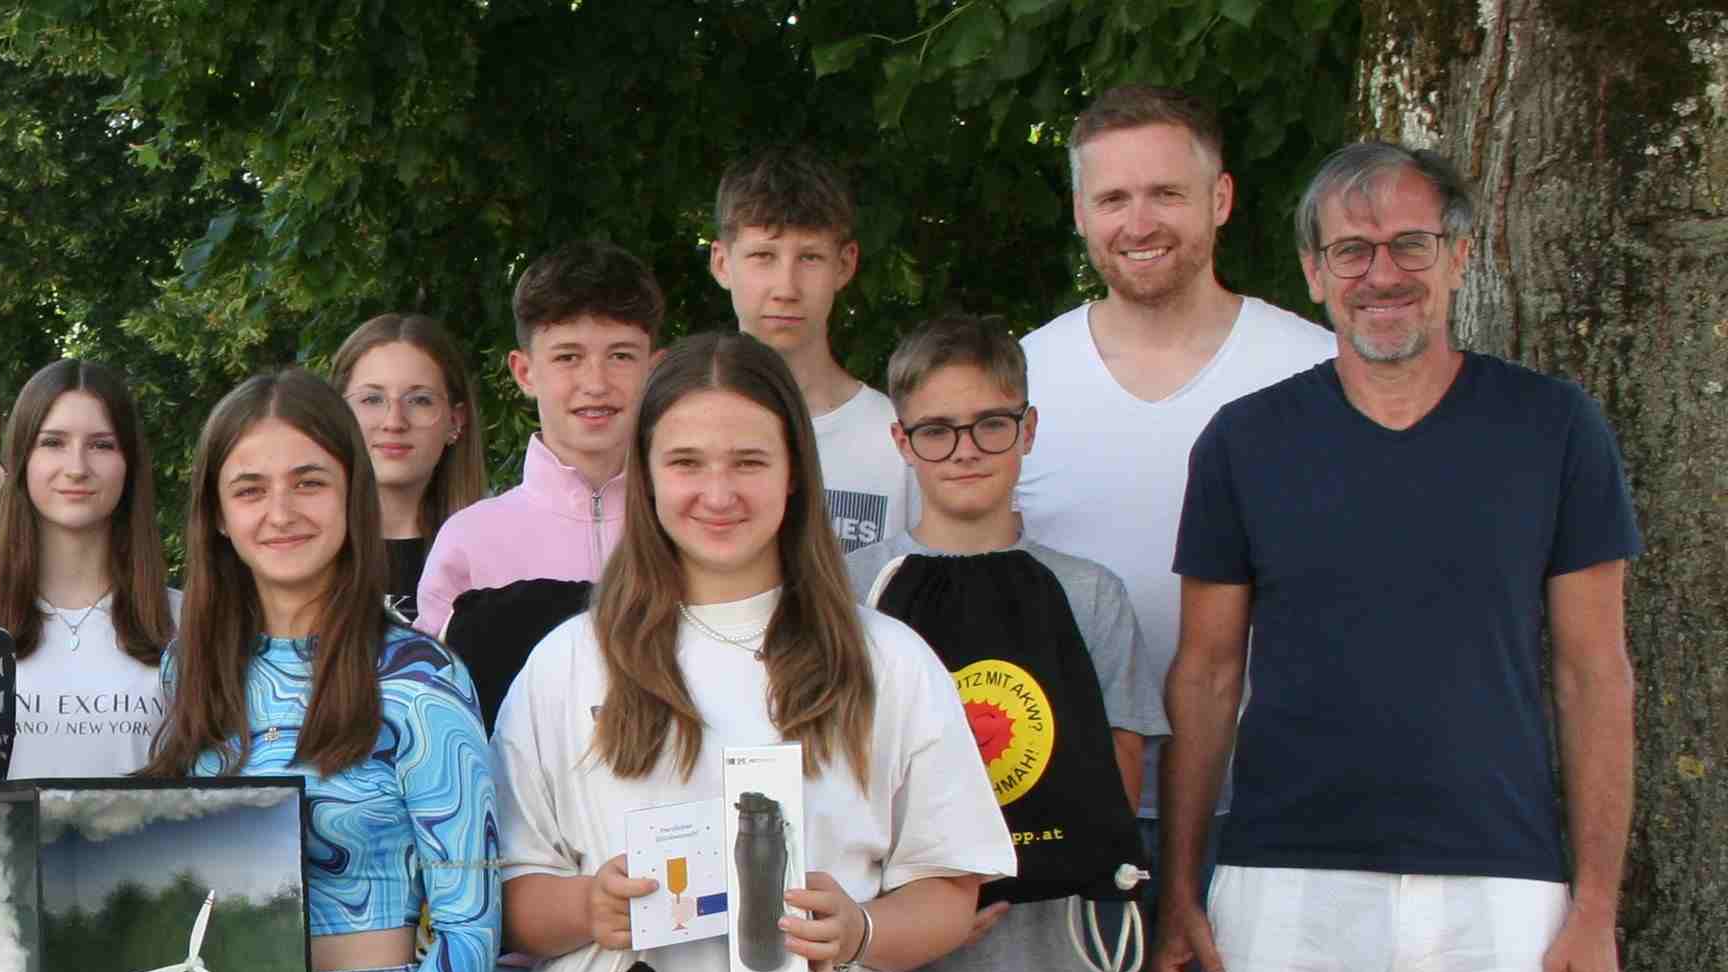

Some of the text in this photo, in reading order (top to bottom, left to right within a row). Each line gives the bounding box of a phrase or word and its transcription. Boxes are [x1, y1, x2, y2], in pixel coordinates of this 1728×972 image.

[15, 694, 41, 713] NI
[985, 671, 1014, 689] MIT
[1010, 683, 1044, 733] AKW?
[66, 720, 103, 736] NEW
[109, 720, 153, 737] YORK
[1011, 828, 1064, 845] pp.at
